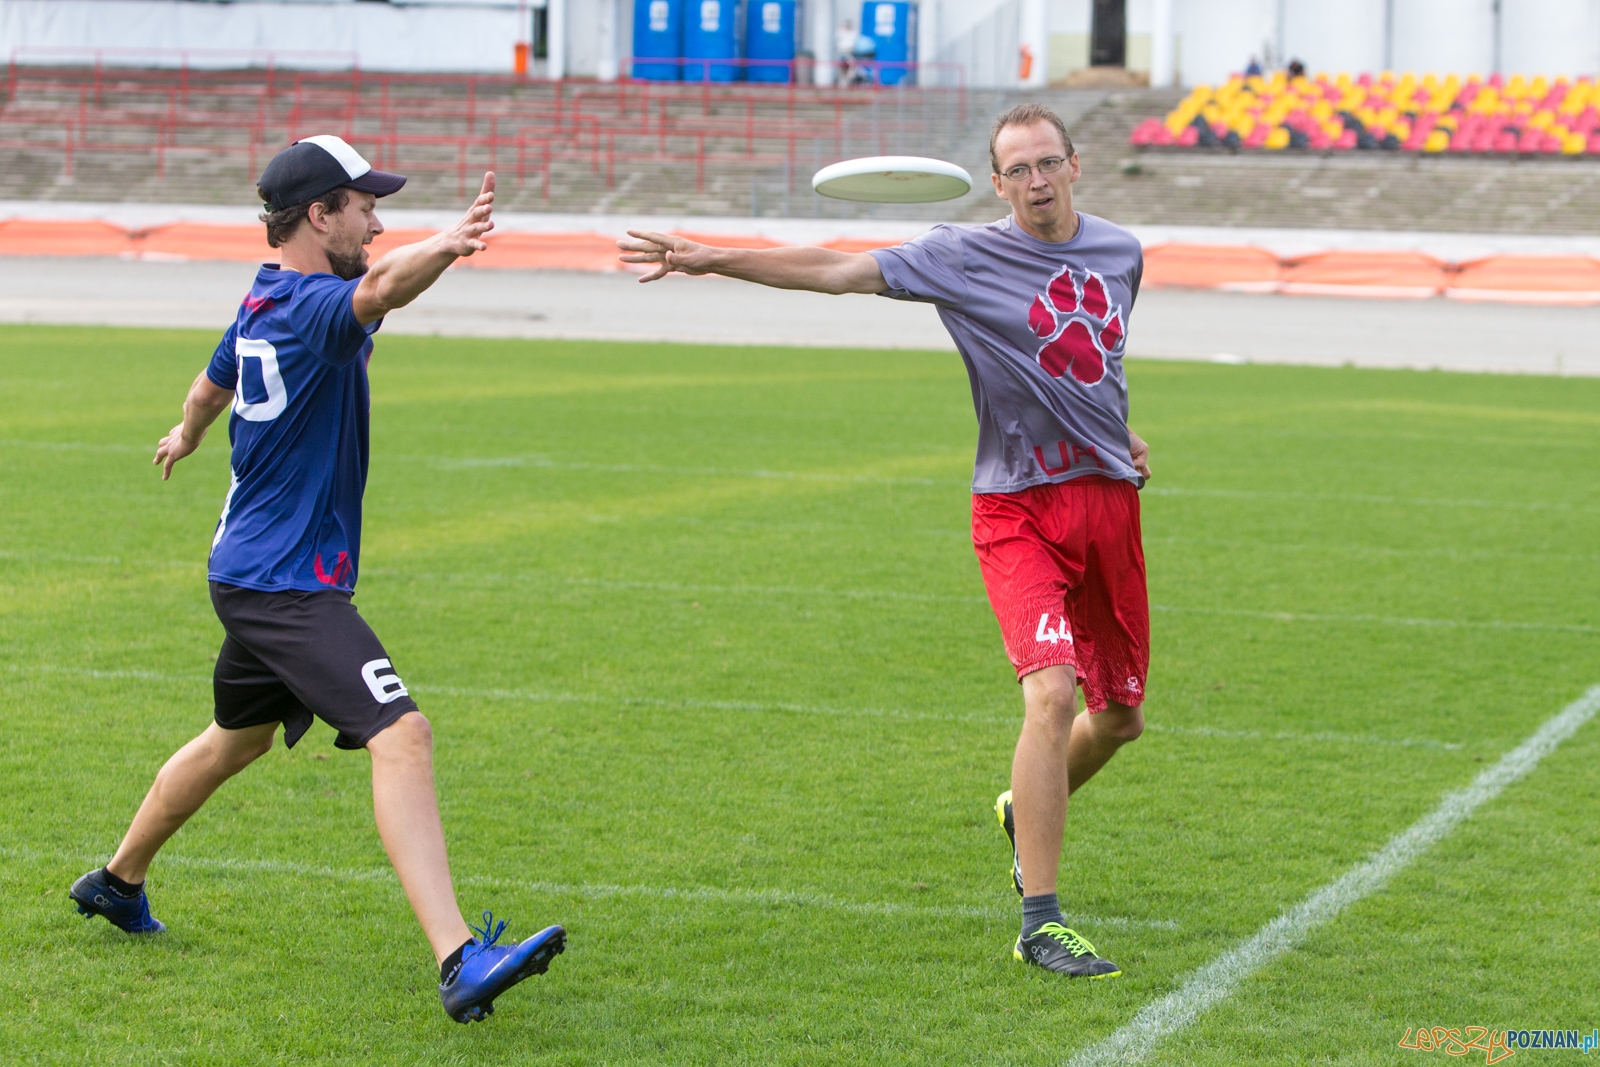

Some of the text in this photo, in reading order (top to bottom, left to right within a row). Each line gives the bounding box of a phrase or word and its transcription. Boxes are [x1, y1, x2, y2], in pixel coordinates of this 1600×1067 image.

[230, 337, 288, 422] 0
[361, 658, 408, 704] 6
[93, 894, 114, 909] CR7
